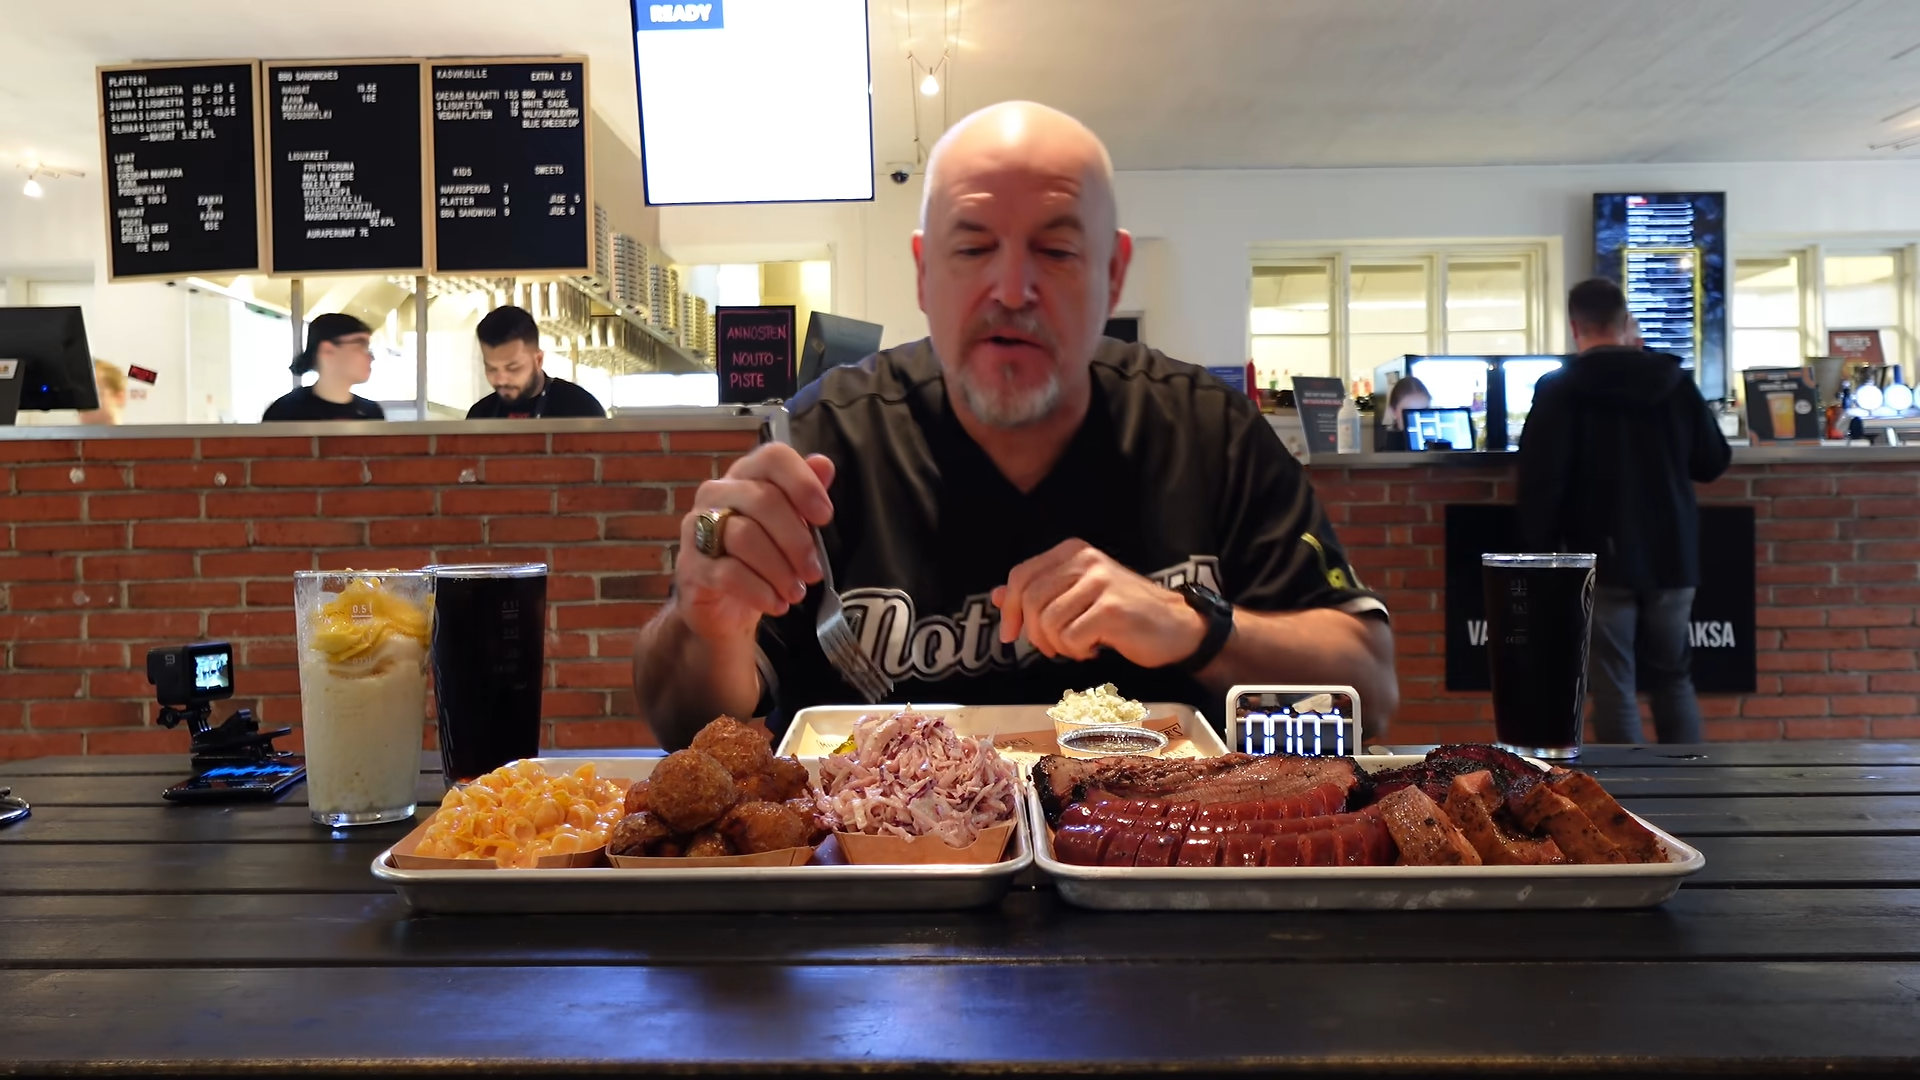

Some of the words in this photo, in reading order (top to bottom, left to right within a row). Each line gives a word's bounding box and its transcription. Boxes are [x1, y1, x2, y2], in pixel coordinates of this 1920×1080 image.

[650, 4, 711, 22] READY
[531, 71, 554, 81] EXTRA
[466, 89, 499, 100] SALAATTI
[542, 89, 566, 99] SAUCE
[522, 100, 543, 109] WHITE
[547, 100, 569, 108] SAUCE
[438, 111, 461, 120] VEGAN
[462, 110, 493, 120] PLATTER
[522, 119, 540, 129] BLUE
[542, 119, 567, 128] CHEESE
[568, 118, 579, 128] DIP
[453, 167, 472, 177] KIDS
[534, 165, 564, 175] SWEETS
[440, 196, 475, 206] PLATTER
[727, 325, 787, 341] ANNOSTEN
